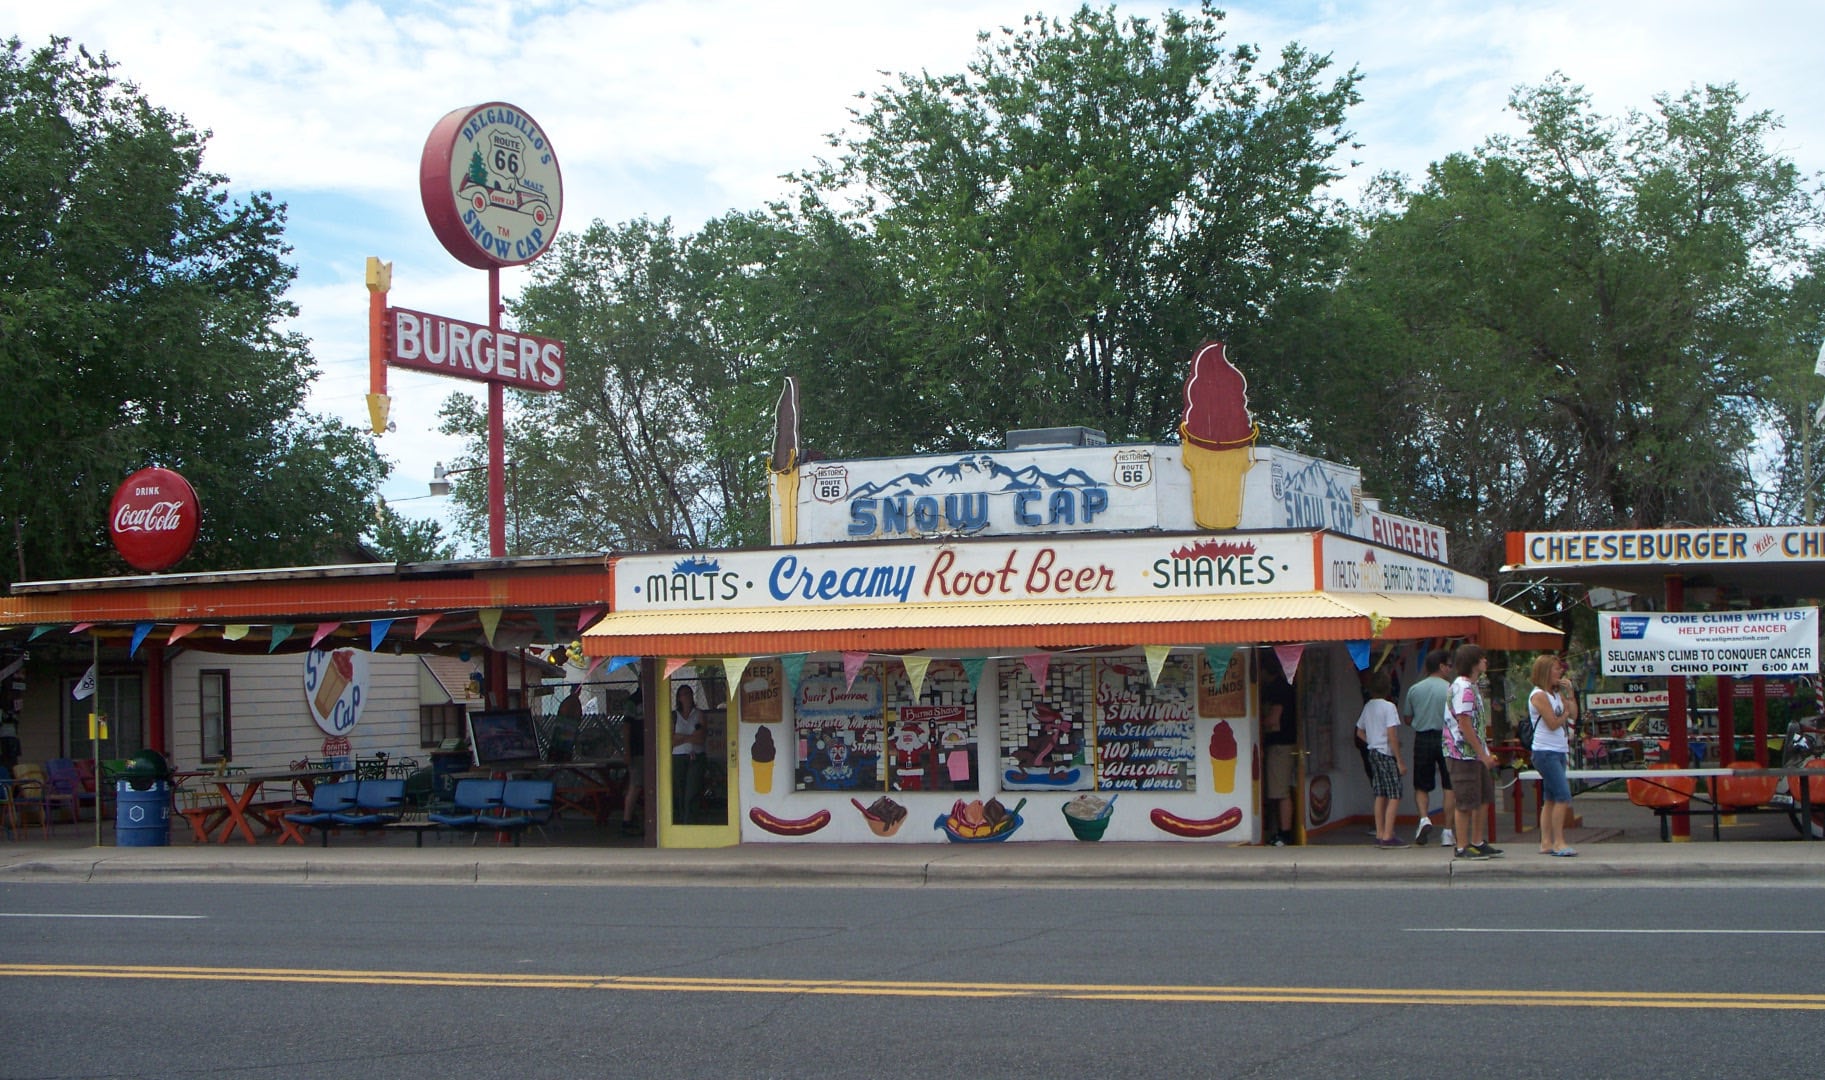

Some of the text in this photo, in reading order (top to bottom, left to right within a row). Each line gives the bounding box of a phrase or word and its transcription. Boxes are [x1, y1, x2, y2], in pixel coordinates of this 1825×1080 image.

[463, 108, 551, 165] DELGADILLO'S
[494, 135, 520, 149] ROUTE
[494, 150, 518, 174] 66
[523, 179, 544, 191] MALT
[463, 209, 544, 259] SNOW CAP
[497, 225, 509, 239] TM
[396, 311, 562, 387] BURGERS
[1118, 453, 1148, 461] HISTORIC
[818, 469, 844, 477] HISTORIC
[1123, 470, 1142, 482] 66
[135, 487, 160, 496] DRINK
[821, 485, 840, 498] 66
[114, 501, 184, 533] Coca-Cola
[848, 487, 1109, 536] SNOW CAP
[1284, 491, 1353, 535] SNOW CAP
[1372, 515, 1439, 561] BURGERS
[1529, 532, 1748, 562] CHEESEBURGER
[1753, 534, 1777, 555] With
[647, 547, 1275, 603] MALTS Creamy Root Beer SHAKES
[1332, 559, 1357, 589] MALTS
[1383, 563, 1413, 591] BURRITOS
[1661, 611, 1806, 624] COME CLIMB WITH US!
[1678, 624, 1787, 635] HELP FIGHT CANCER
[1608, 647, 1811, 662] SELIGMAN'S CLIMB TO CONQUER CANCER
[1203, 657, 1238, 669] KP
[1610, 662, 1809, 673] JULY 18 CHINO POINT 6:00 AM
[744, 666, 774, 677] KEEP
[1208, 681, 1244, 697] HANDS
[1594, 694, 1669, 705] Juan's Garde
[334, 685, 360, 731] Cap
[904, 706, 960, 720] Burma Shave
[1098, 726, 1117, 737] FOR
[1104, 742, 1130, 759] 100
[1105, 761, 1178, 777] WELCOME
[1142, 779, 1182, 789] WORLD
